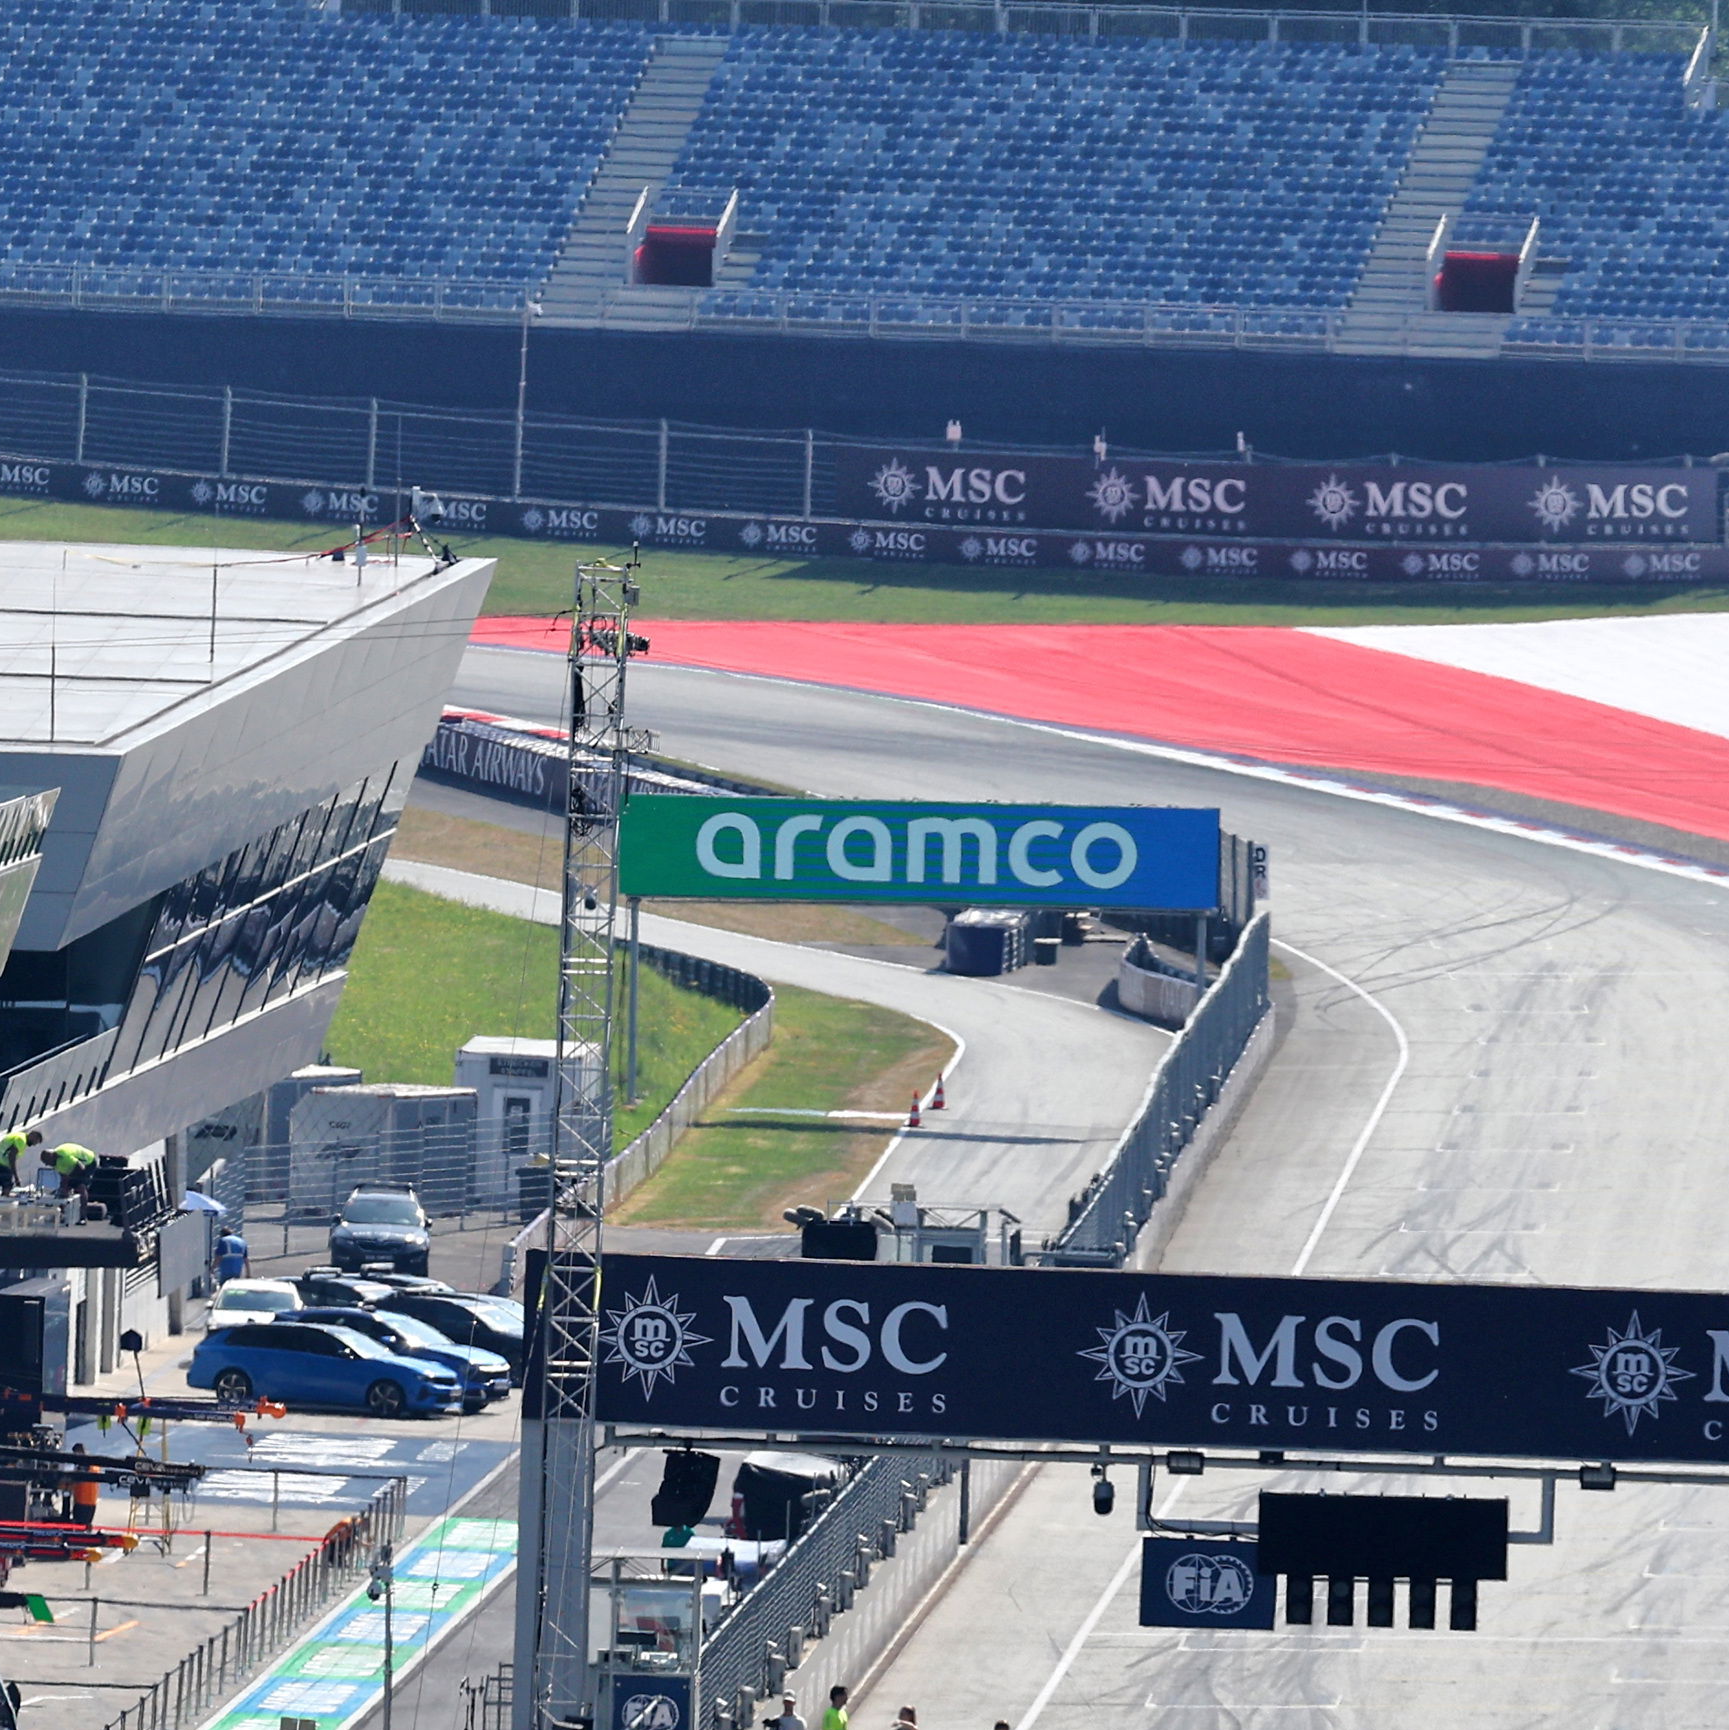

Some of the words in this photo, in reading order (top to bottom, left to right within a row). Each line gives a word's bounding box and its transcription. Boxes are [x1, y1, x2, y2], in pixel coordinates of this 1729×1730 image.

[0, 464, 50, 486] MSC
[110, 474, 160, 495] MSC
[925, 466, 1027, 505] MSC
[217, 483, 267, 504] MSC
[329, 492, 379, 513] MSC
[1145, 475, 1247, 514] MSC
[1365, 482, 1468, 519] MSC
[1586, 484, 1688, 519] MSC
[548, 510, 599, 530] MSC
[656, 518, 707, 538] MSC
[767, 526, 817, 544] MSC
[874, 532, 926, 552] MSC
[986, 538, 1038, 557] MSC
[1095, 542, 1146, 562] MSC
[1207, 548, 1258, 567] MSC
[1316, 551, 1368, 570] MSC
[1428, 553, 1479, 571] MSC
[1538, 553, 1589, 572] MSC
[1649, 553, 1701, 572] MSC
[421, 729, 468, 775] ATAR
[472, 741, 547, 795] AIRWAYS
[696, 812, 1138, 889] aramco
[720, 1295, 949, 1377] MSC
[1212, 1312, 1440, 1393] MSC
[719, 1386, 947, 1415] CRUISES
[1212, 1403, 1439, 1433] CRUISES
